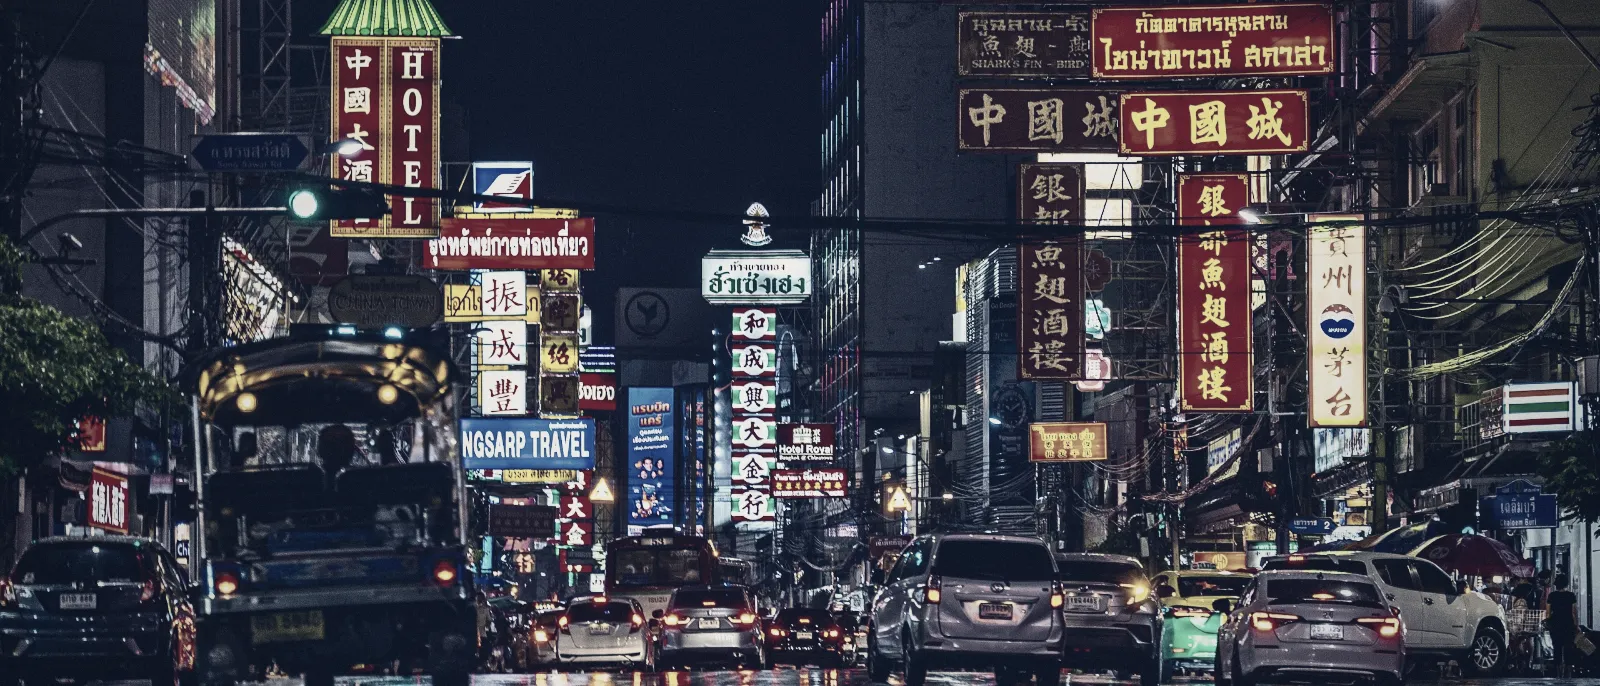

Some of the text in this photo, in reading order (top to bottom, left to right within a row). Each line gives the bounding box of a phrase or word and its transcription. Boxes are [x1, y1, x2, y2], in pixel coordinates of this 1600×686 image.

[1135, 12, 1288, 38] ภัตตาคารหูฉลาม
[980, 35, 1037, 58] 魚翅
[1100, 37, 1326, 71] ไชน่าทาวน์ สกาล่า
[972, 59, 1021, 69] SHARK'S
[1024, 59, 1042, 69] FIN
[968, 94, 1117, 146] 中國城
[1130, 97, 1292, 149] 中國城
[401, 51, 425, 225] HOTEL
[709, 265, 806, 294] ฮั่วเซ่งเฮง
[335, 295, 436, 311] CHINA TOWN
[1197, 185, 1232, 403] 銀都魚翅酒樓
[484, 278, 526, 413] 振成豐
[1324, 347, 1353, 417] 茅台
[742, 310, 766, 516] 和成興大金行
[462, 431, 589, 459] NGSARP TRAVEL
[778, 444, 833, 455] Hotel Royal
[1500, 496, 1536, 518] เฉลิมบุรี
[1323, 520, 1331, 530] 2
[1500, 518, 1537, 527] Chaloem Buri
